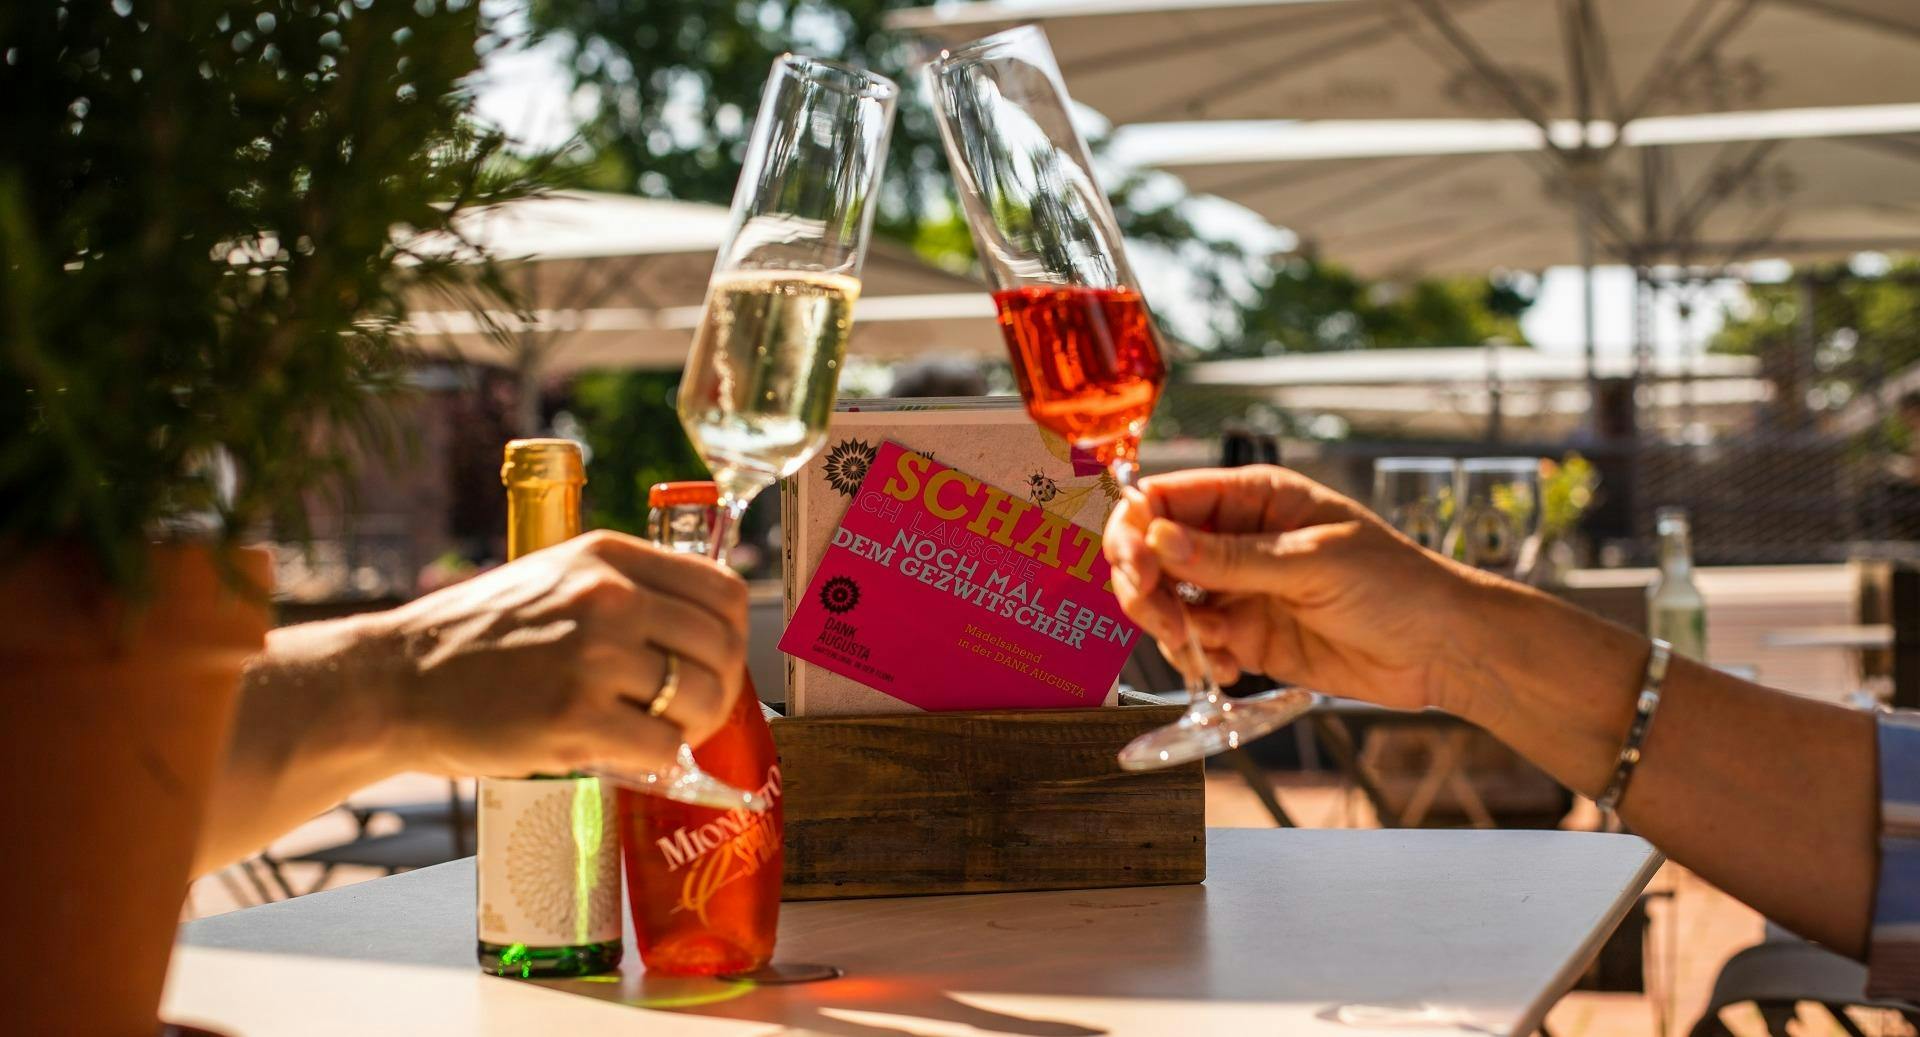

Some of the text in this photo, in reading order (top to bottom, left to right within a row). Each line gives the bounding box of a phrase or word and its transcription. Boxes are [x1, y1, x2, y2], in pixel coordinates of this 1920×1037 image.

[883, 451, 1115, 593] SCHAT
[909, 511, 1042, 584] LAUSCHE
[831, 526, 1087, 650] DEM GEZWITSCHER
[892, 528, 1135, 648] NOCH MAL EBEN
[817, 630, 872, 661] AUGUSTA
[824, 616, 858, 639] DANK
[972, 643, 993, 658] der
[993, 651, 1030, 674] DANK
[1030, 668, 1086, 698] AUGUSTA
